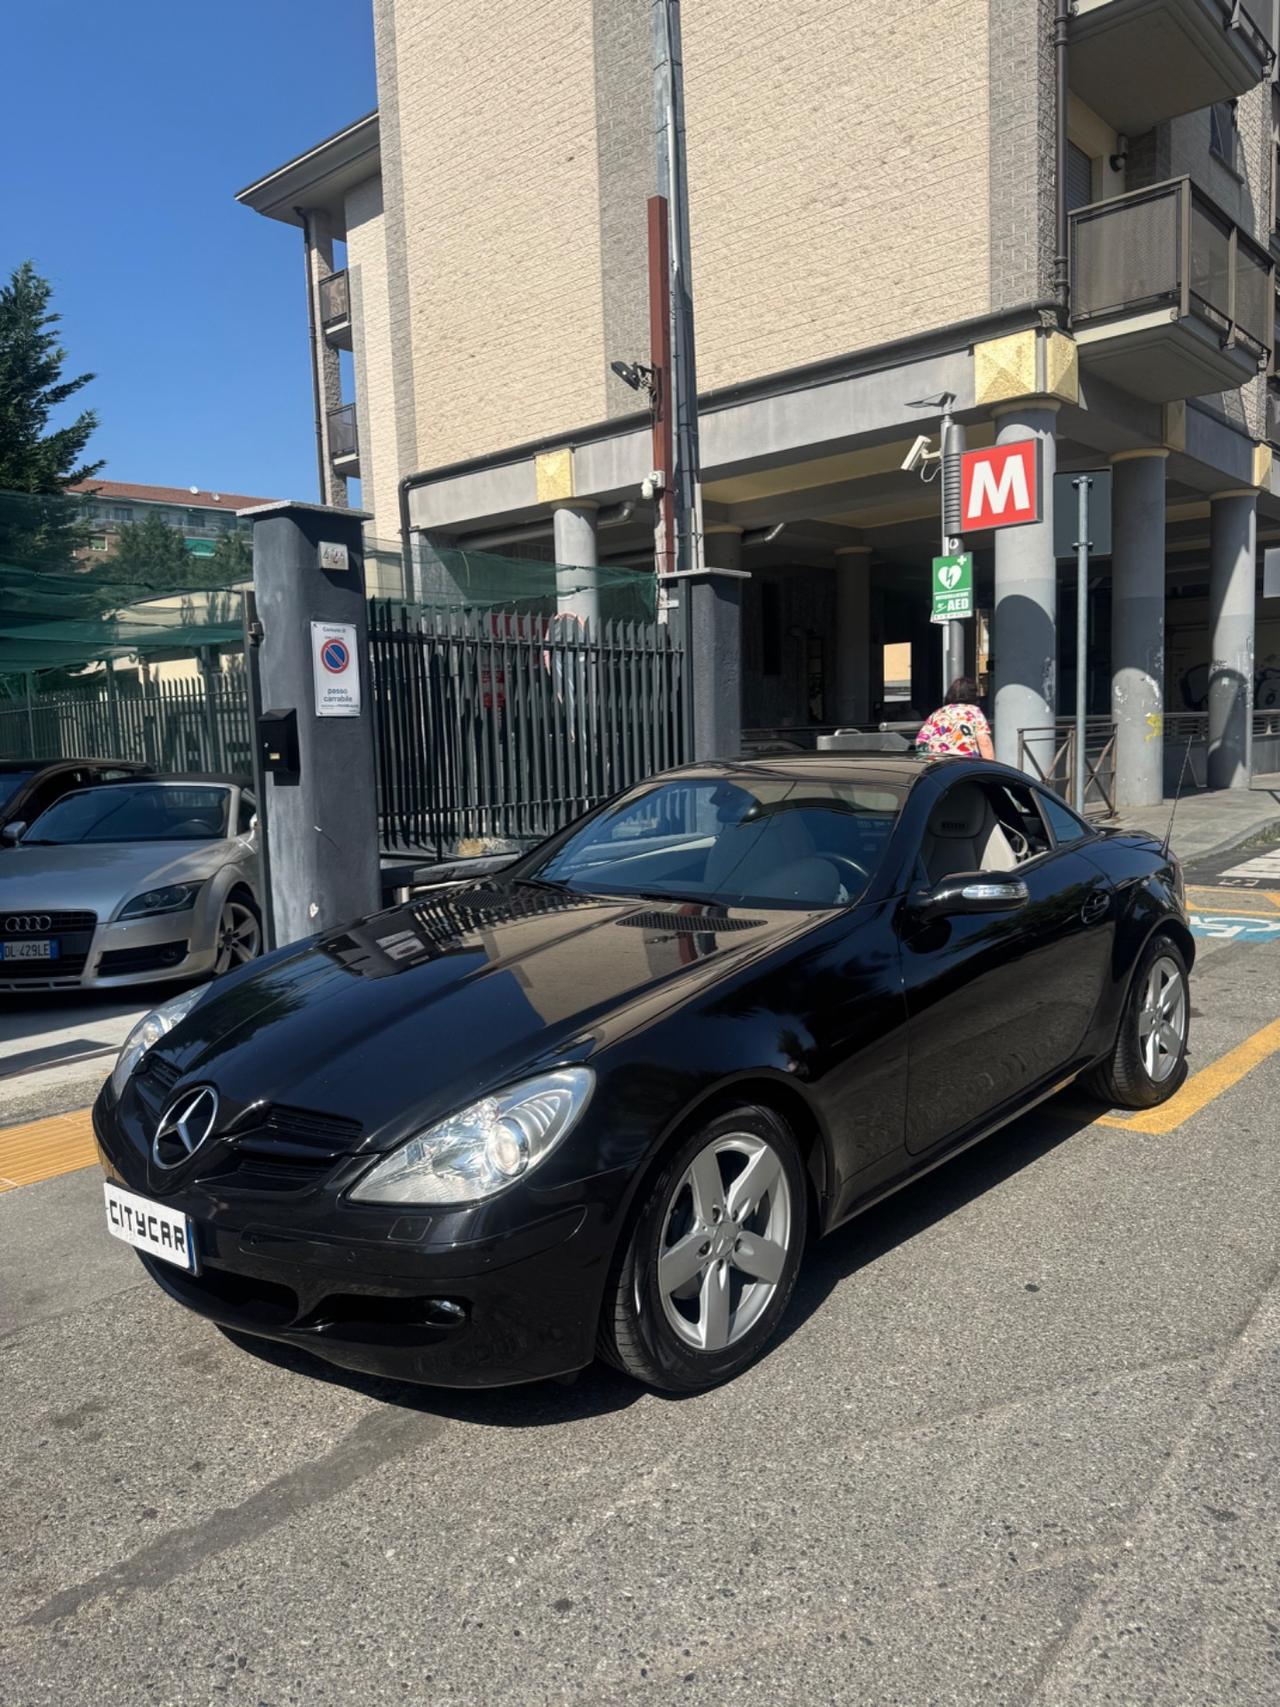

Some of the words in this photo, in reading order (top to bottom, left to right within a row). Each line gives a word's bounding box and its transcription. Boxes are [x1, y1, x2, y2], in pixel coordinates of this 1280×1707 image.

[967, 454, 1030, 519] M
[947, 598, 969, 611] AED
[109, 1199, 185, 1254] CITYCAR
